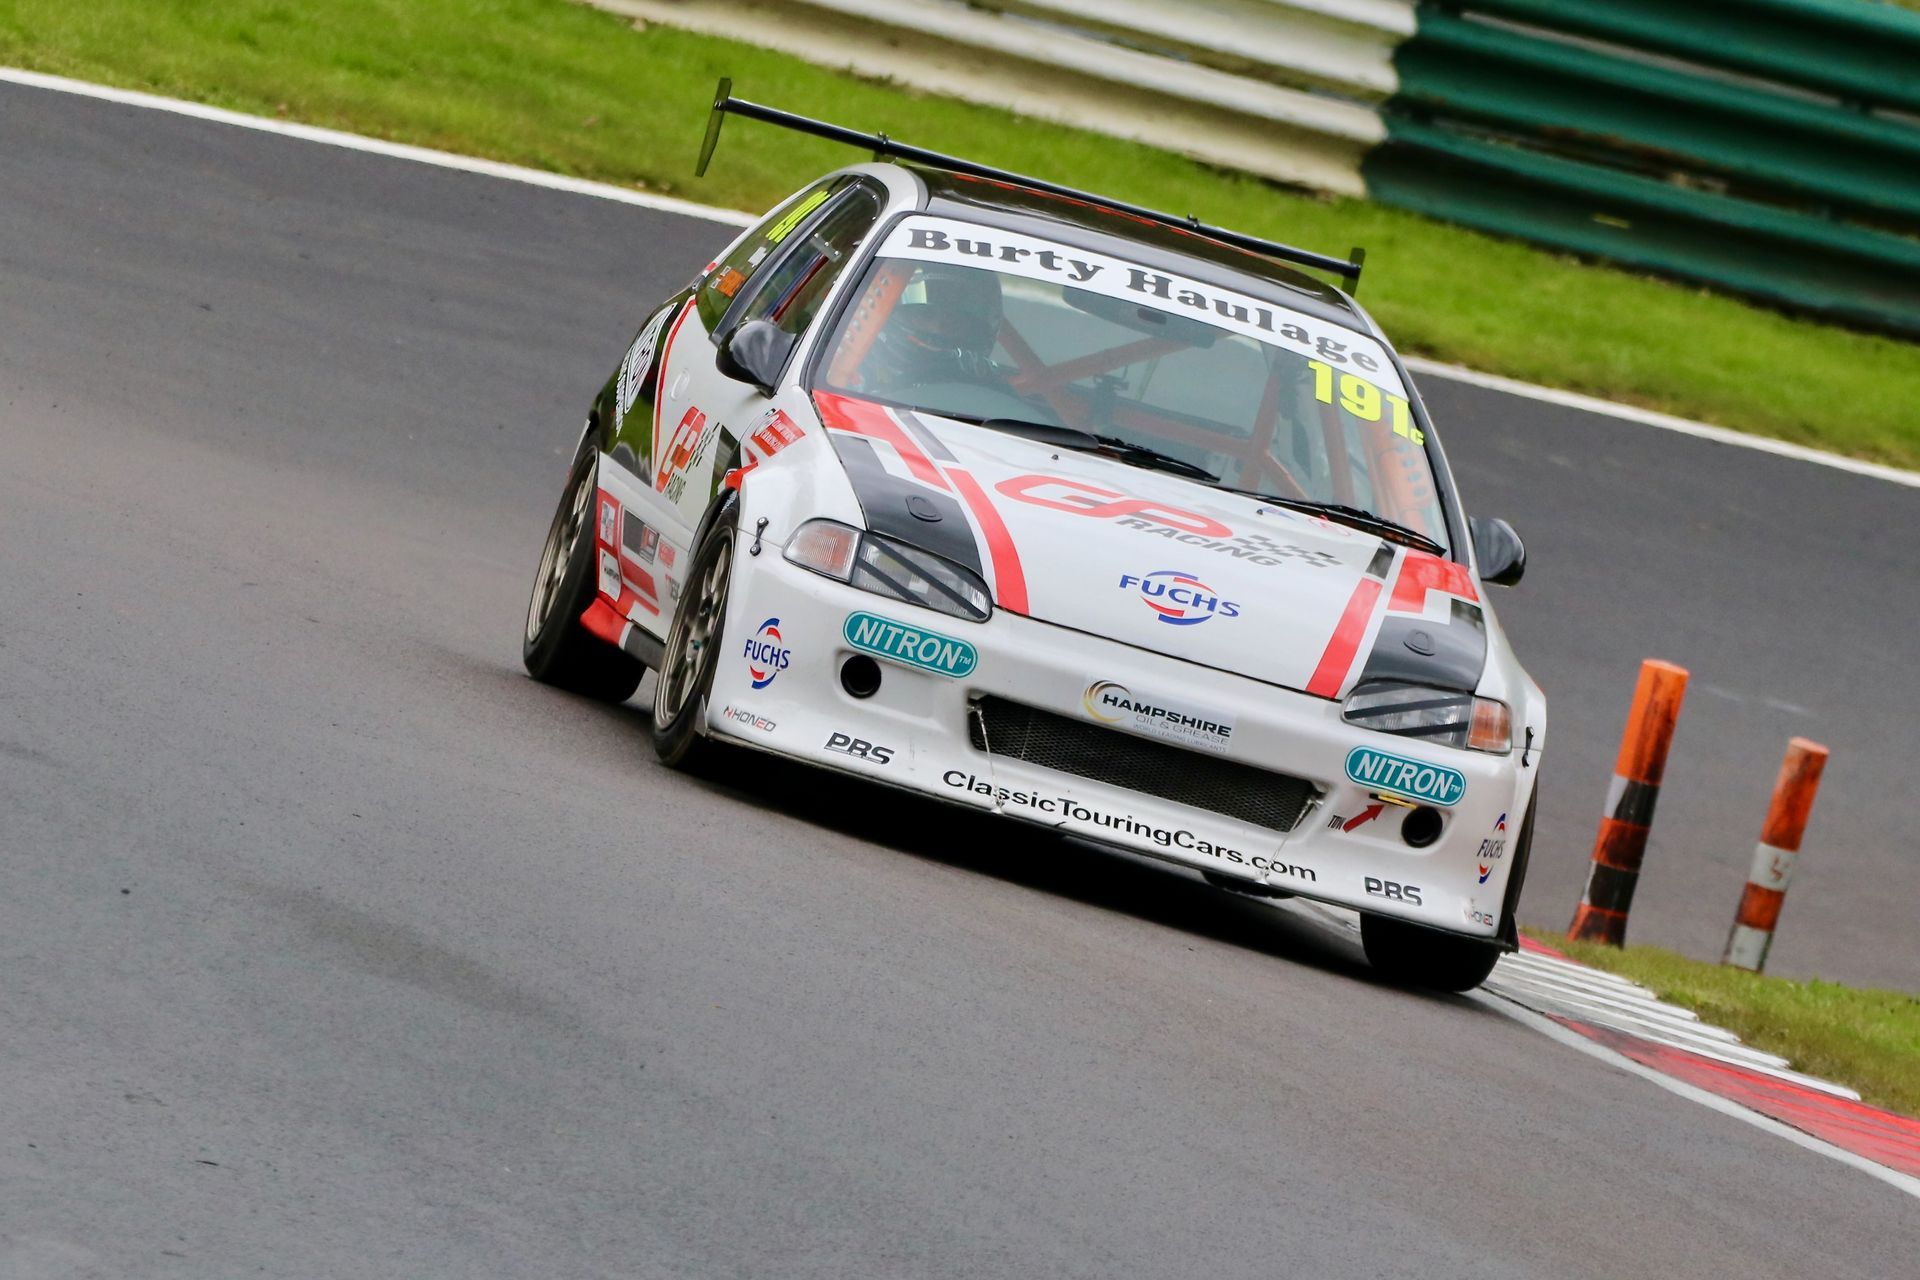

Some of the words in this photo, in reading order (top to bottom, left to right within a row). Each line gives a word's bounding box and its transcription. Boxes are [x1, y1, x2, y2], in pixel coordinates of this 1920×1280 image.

[906, 228, 1104, 281] Burty
[1126, 268, 1380, 373] Haulage
[1115, 518, 1282, 567] RACING
[1118, 574, 1241, 618] FUCHS
[743, 639, 791, 670] FUCHS
[1102, 694, 1232, 738] HAMPSHIRE
[1135, 715, 1156, 726] OIL
[1172, 725, 1230, 746] GREASE
[943, 770, 1317, 882] ClassicTouringCars.com
[1476, 838, 1505, 859] FUCHS
